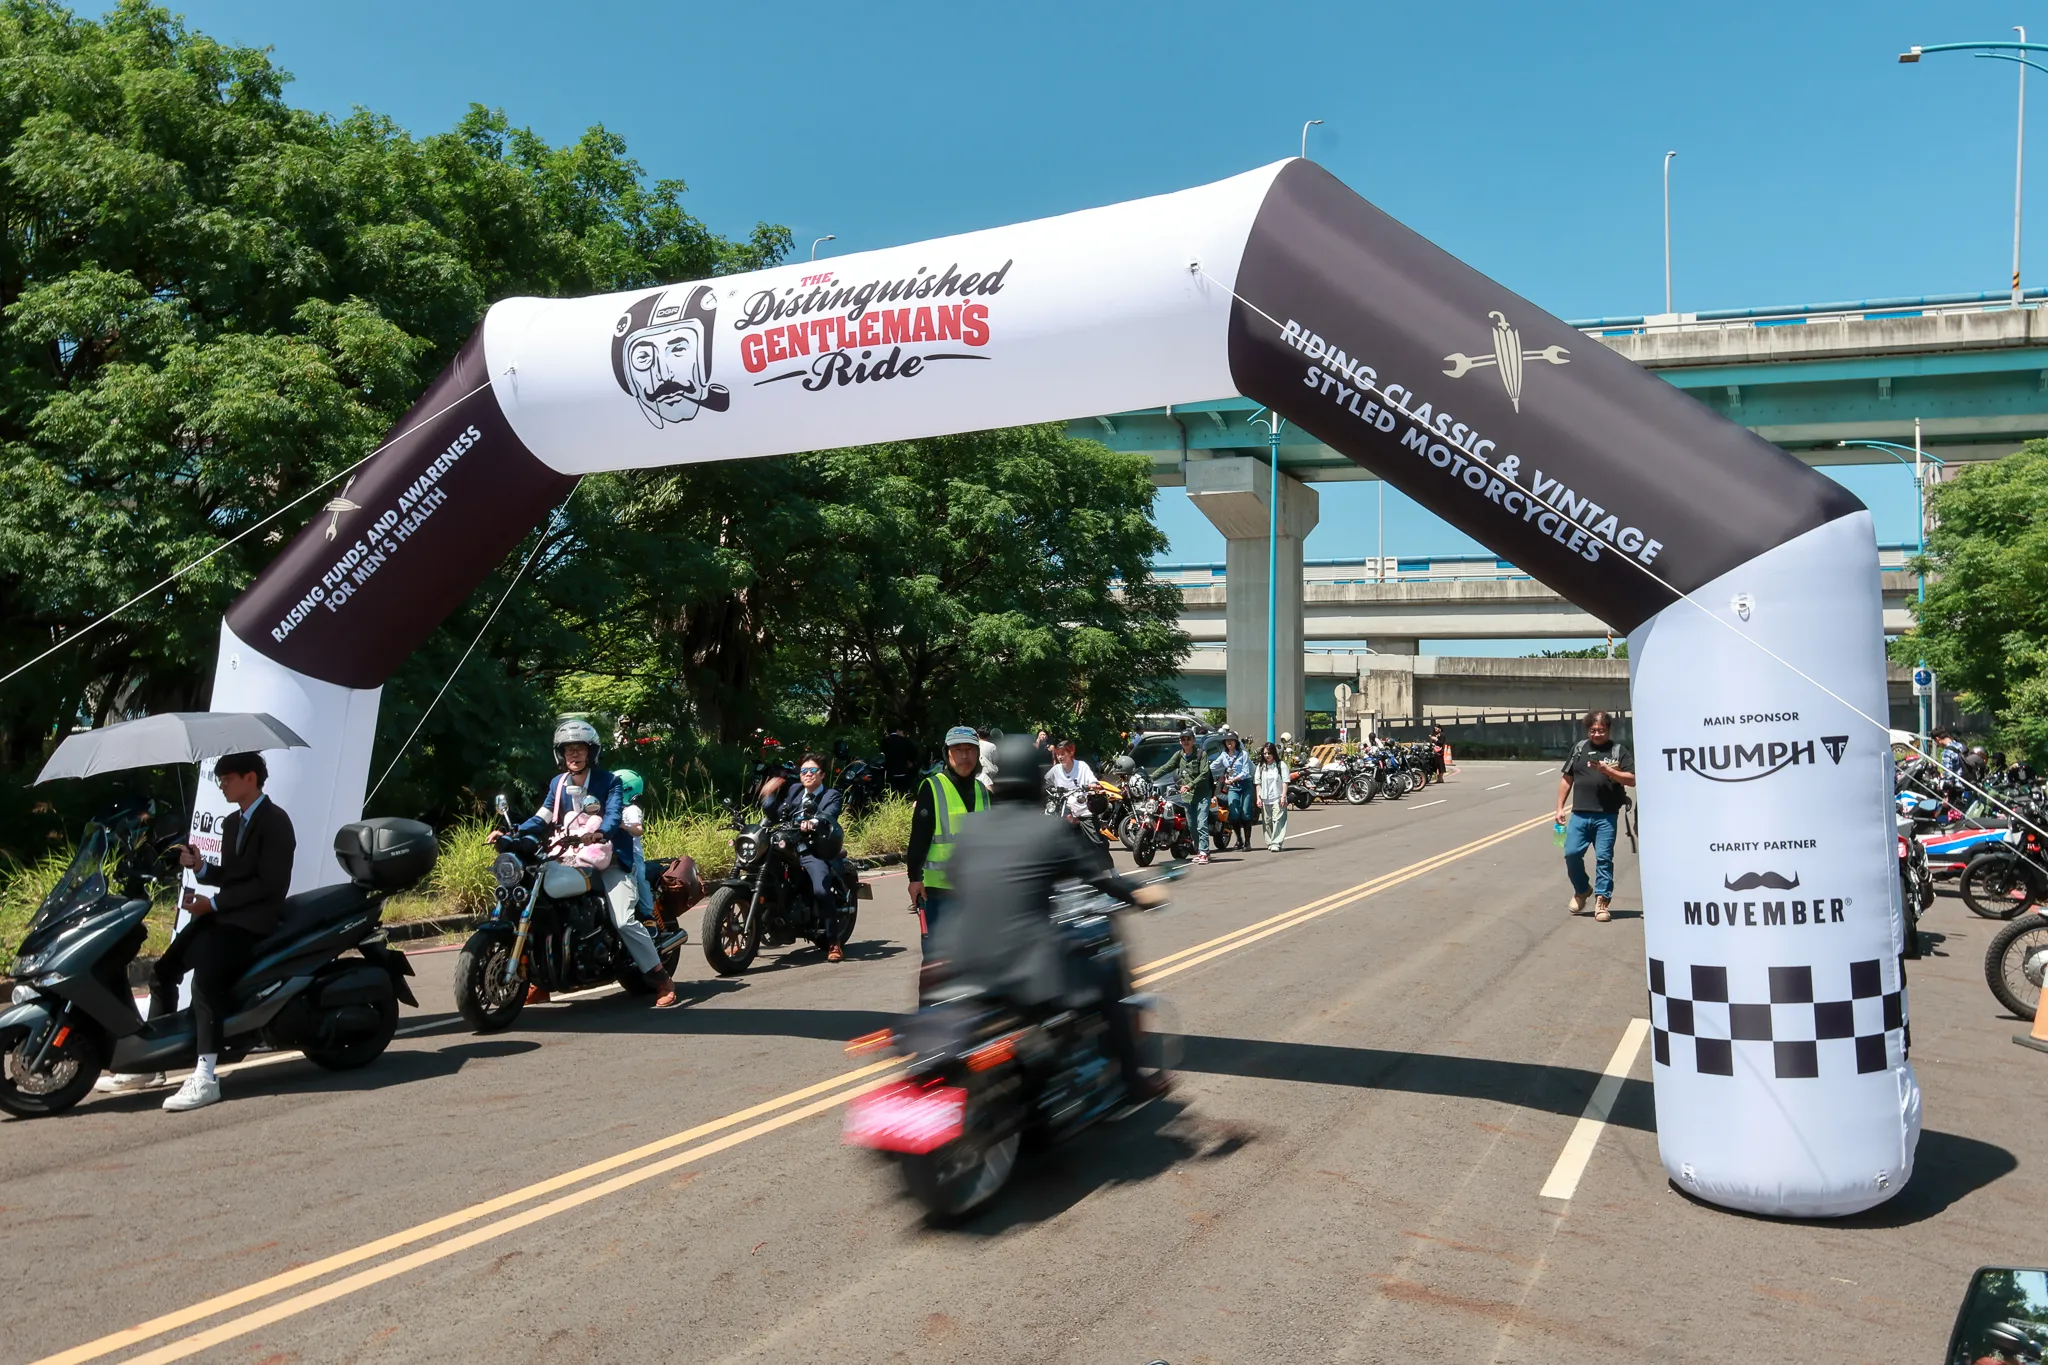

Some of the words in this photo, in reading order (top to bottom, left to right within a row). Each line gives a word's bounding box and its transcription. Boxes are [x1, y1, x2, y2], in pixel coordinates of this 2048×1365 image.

[734, 259, 1013, 331] Distinguished
[800, 272, 834, 287] THE
[657, 307, 679, 317] DGR
[741, 299, 990, 373] GENTLEMAN'S
[802, 346, 924, 391] Ride
[1279, 318, 1378, 391] RIDING
[1383, 383, 1497, 463] CLASSIC
[1496, 454, 1522, 483] &
[1531, 469, 1664, 566] VINTAGE
[1303, 366, 1396, 433] STYLED
[1400, 427, 1605, 563] MOTORCYCLES
[270, 586, 325, 643] RAISING
[322, 540, 369, 590] FUNDS
[366, 509, 398, 546] AND
[397, 424, 482, 514] AWARENESS
[324, 581, 356, 613] FOR
[351, 538, 398, 585] MEN'S
[392, 486, 448, 542] HEALTH
[1703, 715, 1735, 727] MAIN
[1739, 711, 1800, 724] SPONSOR
[1662, 740, 1815, 782] TRIUMPH
[1709, 842, 1759, 852] CHARITY
[1763, 839, 1817, 850] PARTNER
